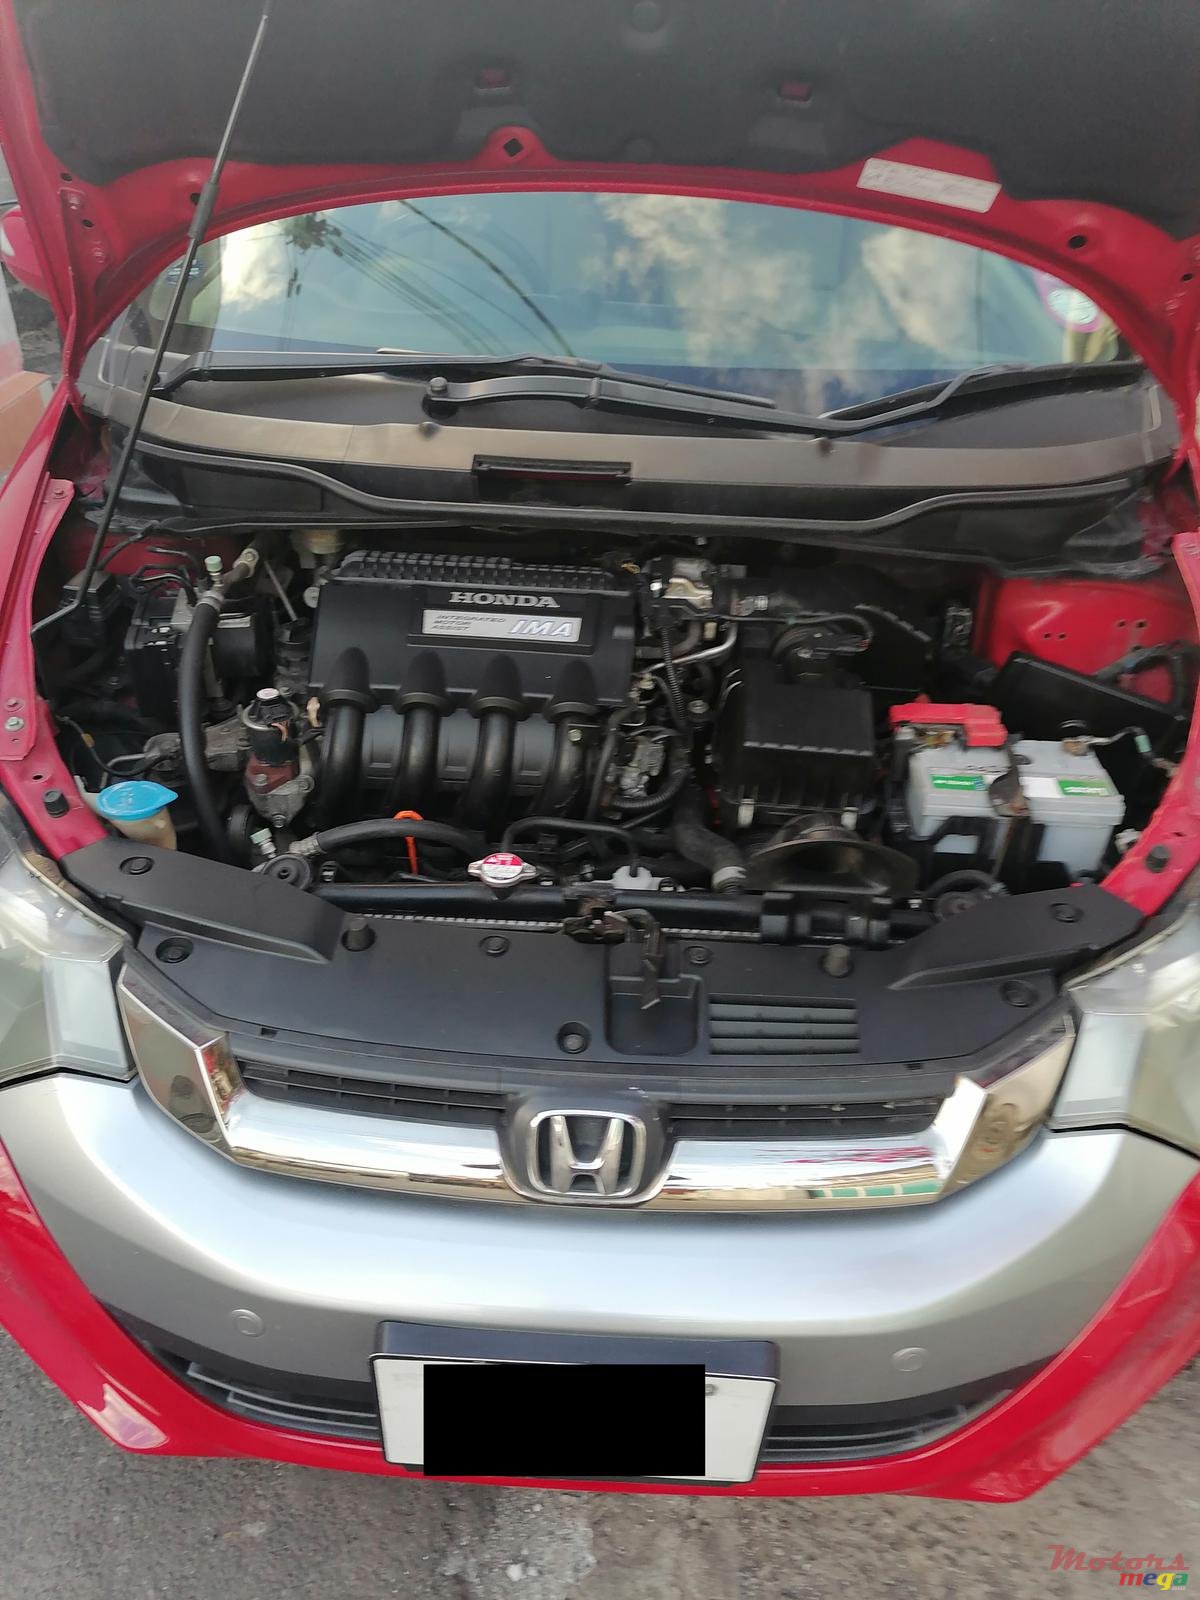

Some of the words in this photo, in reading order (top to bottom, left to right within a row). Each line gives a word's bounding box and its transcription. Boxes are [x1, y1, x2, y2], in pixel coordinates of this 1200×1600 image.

[448, 591, 560, 608] HONDA
[435, 614, 506, 623] INTEGRATED
[508, 619, 573, 637] IMA
